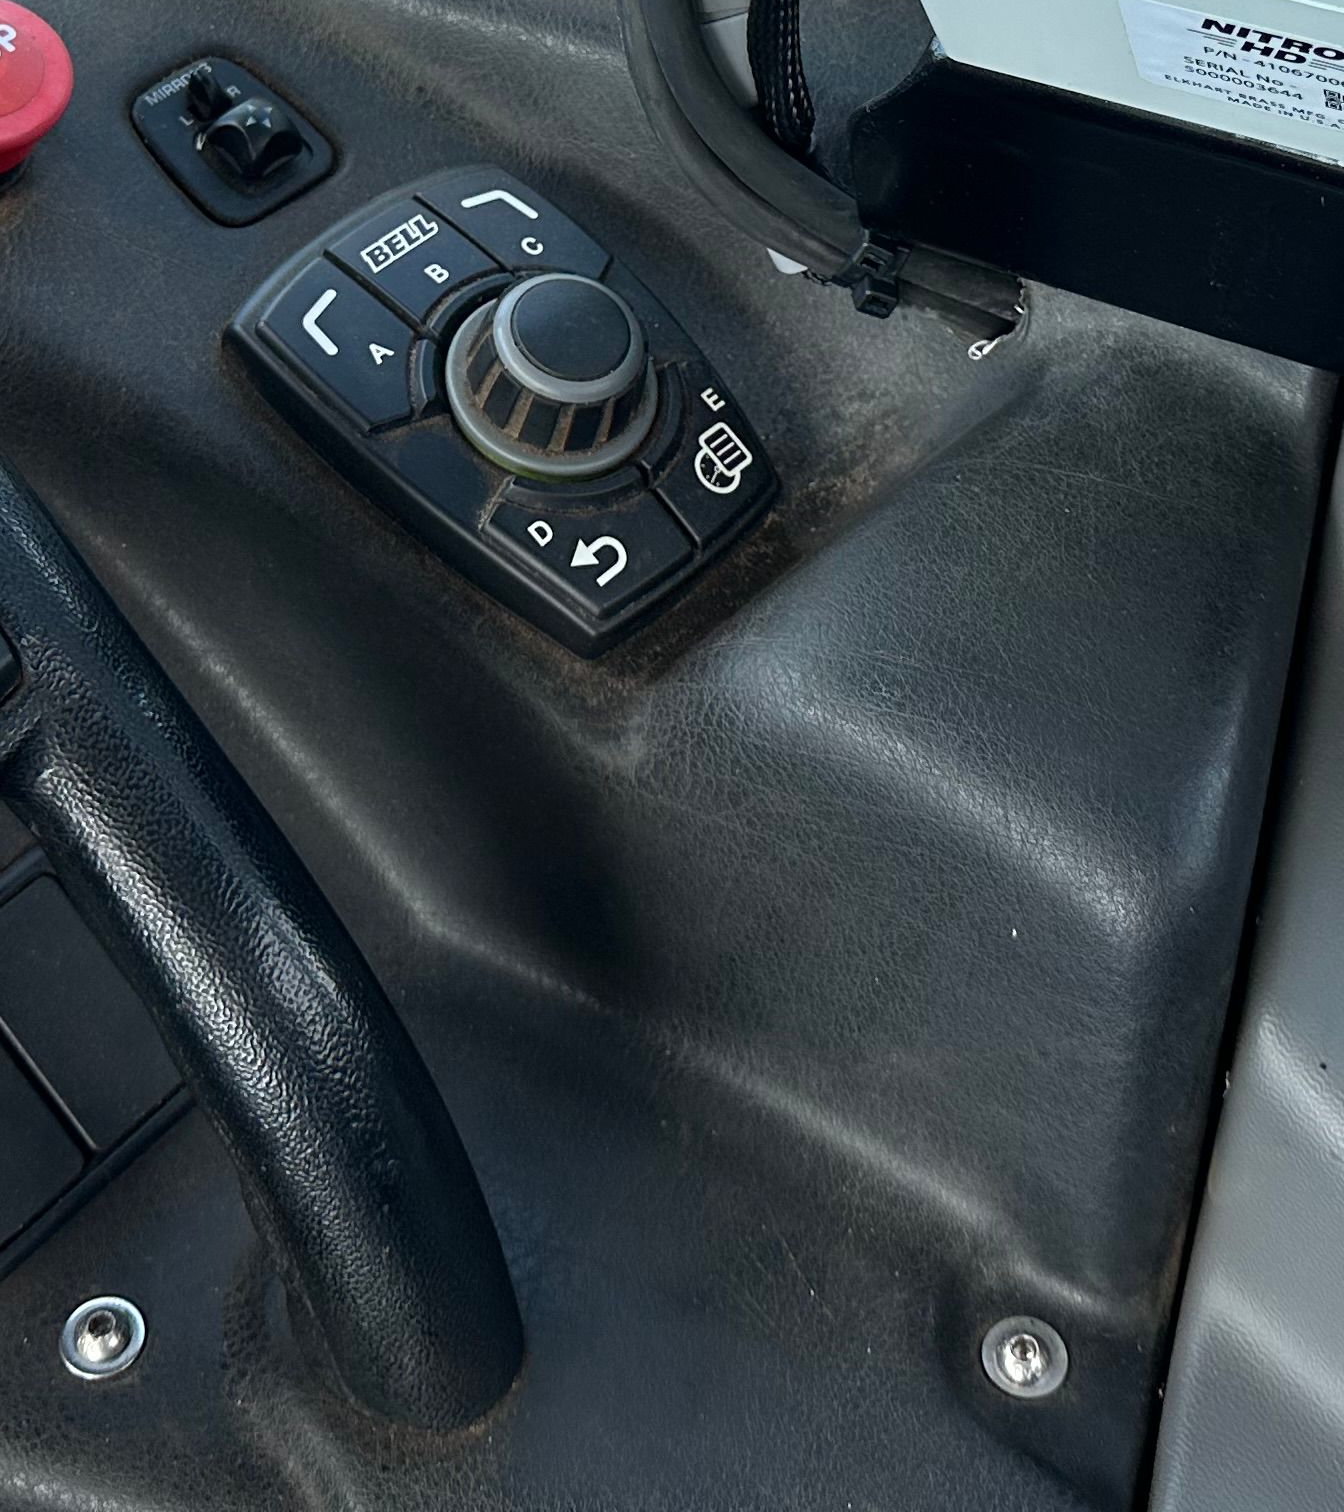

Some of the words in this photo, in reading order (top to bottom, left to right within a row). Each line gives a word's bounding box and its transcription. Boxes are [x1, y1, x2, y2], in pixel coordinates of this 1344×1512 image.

[1204, 45, 1237, 63] P/N
[1240, 41, 1307, 64] HD
[1183, 55, 1249, 80] SERIAL
[1256, 74, 1283, 87] No
[226, 85, 242, 98] R
[1239, 92, 1285, 109] BRASS
[1227, 96, 1271, 112] MADE
[178, 115, 194, 128] L
[361, 214, 439, 273] BELL
[521, 236, 544, 256] C
[425, 263, 450, 284] B
[368, 343, 395, 365] A
[701, 388, 727, 412] E
[527, 520, 554, 547] D
